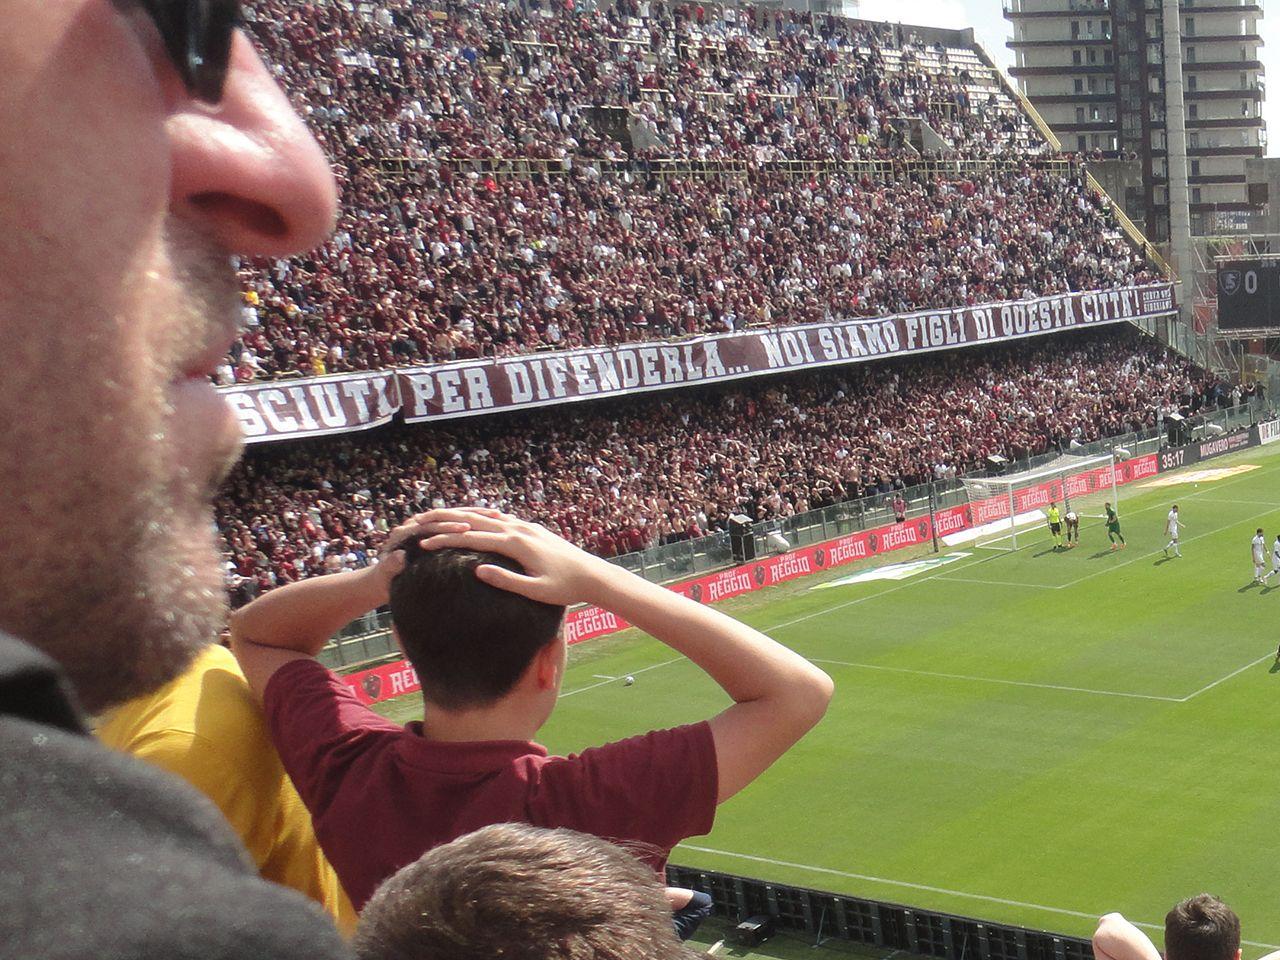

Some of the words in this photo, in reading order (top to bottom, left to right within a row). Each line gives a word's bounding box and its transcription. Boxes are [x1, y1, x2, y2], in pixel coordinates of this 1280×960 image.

[1245, 270, 1257, 294] 0
[224, 377, 399, 436] SCIUTI
[407, 371, 493, 415] PER
[509, 341, 749, 402] DIFENDERLA...
[761, 329, 812, 367] NOI
[822, 321, 900, 360] SIAMO
[906, 314, 967, 350] FIGLI
[976, 309, 996, 340] DI
[1003, 299, 1073, 337] QUESTA
[1083, 290, 1141, 320] CITTA'!
[1133, 461, 1158, 477] REGGIO
[1162, 450, 1185, 469] 35:17
[1099, 469, 1123, 487] REGIO
[1021, 490, 1049, 510] REGGIO
[882, 527, 917, 550] REGGIO
[830, 540, 866, 565] REGGIO
[771, 557, 811, 583] REGGIO
[708, 573, 752, 601] REGGIO
[577, 607, 599, 619] PROF
[567, 611, 618, 642] REGGIO
